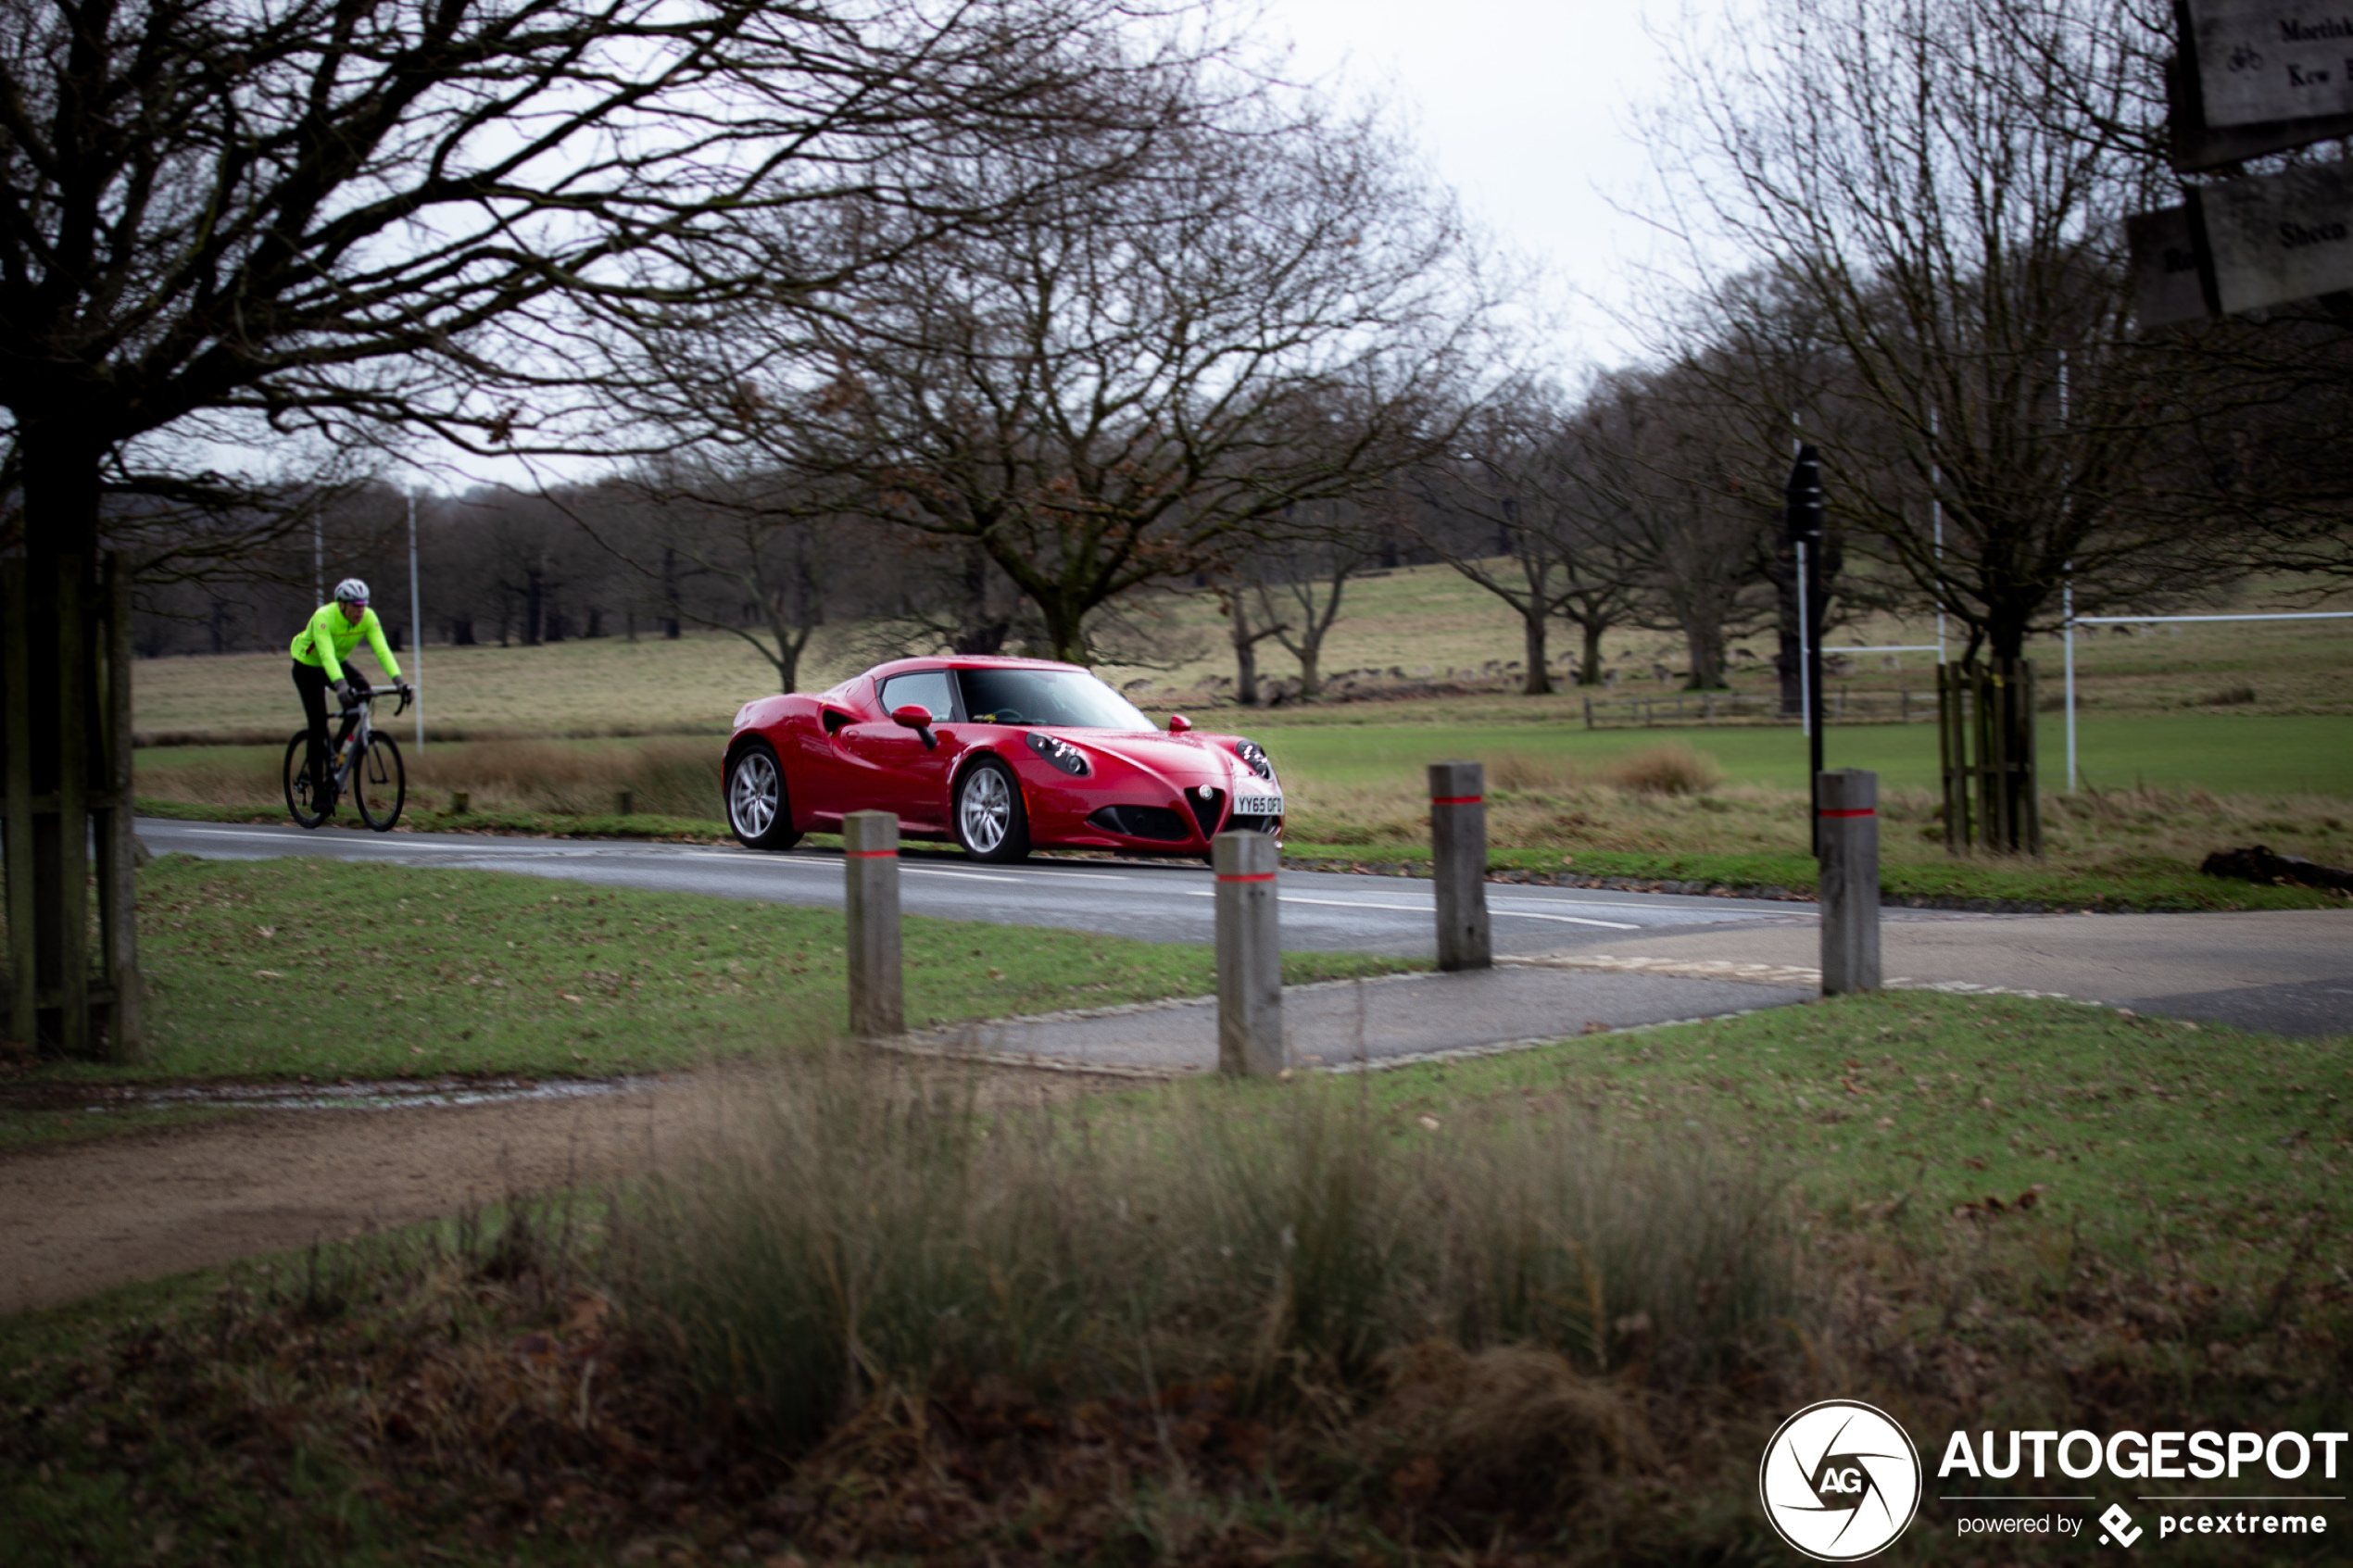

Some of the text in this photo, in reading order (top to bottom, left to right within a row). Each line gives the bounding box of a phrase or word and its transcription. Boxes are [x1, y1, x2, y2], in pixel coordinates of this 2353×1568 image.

[2287, 64, 2330, 88] Kew
[2279, 221, 2347, 248] Sheen
[1239, 797, 1265, 812] YY65
